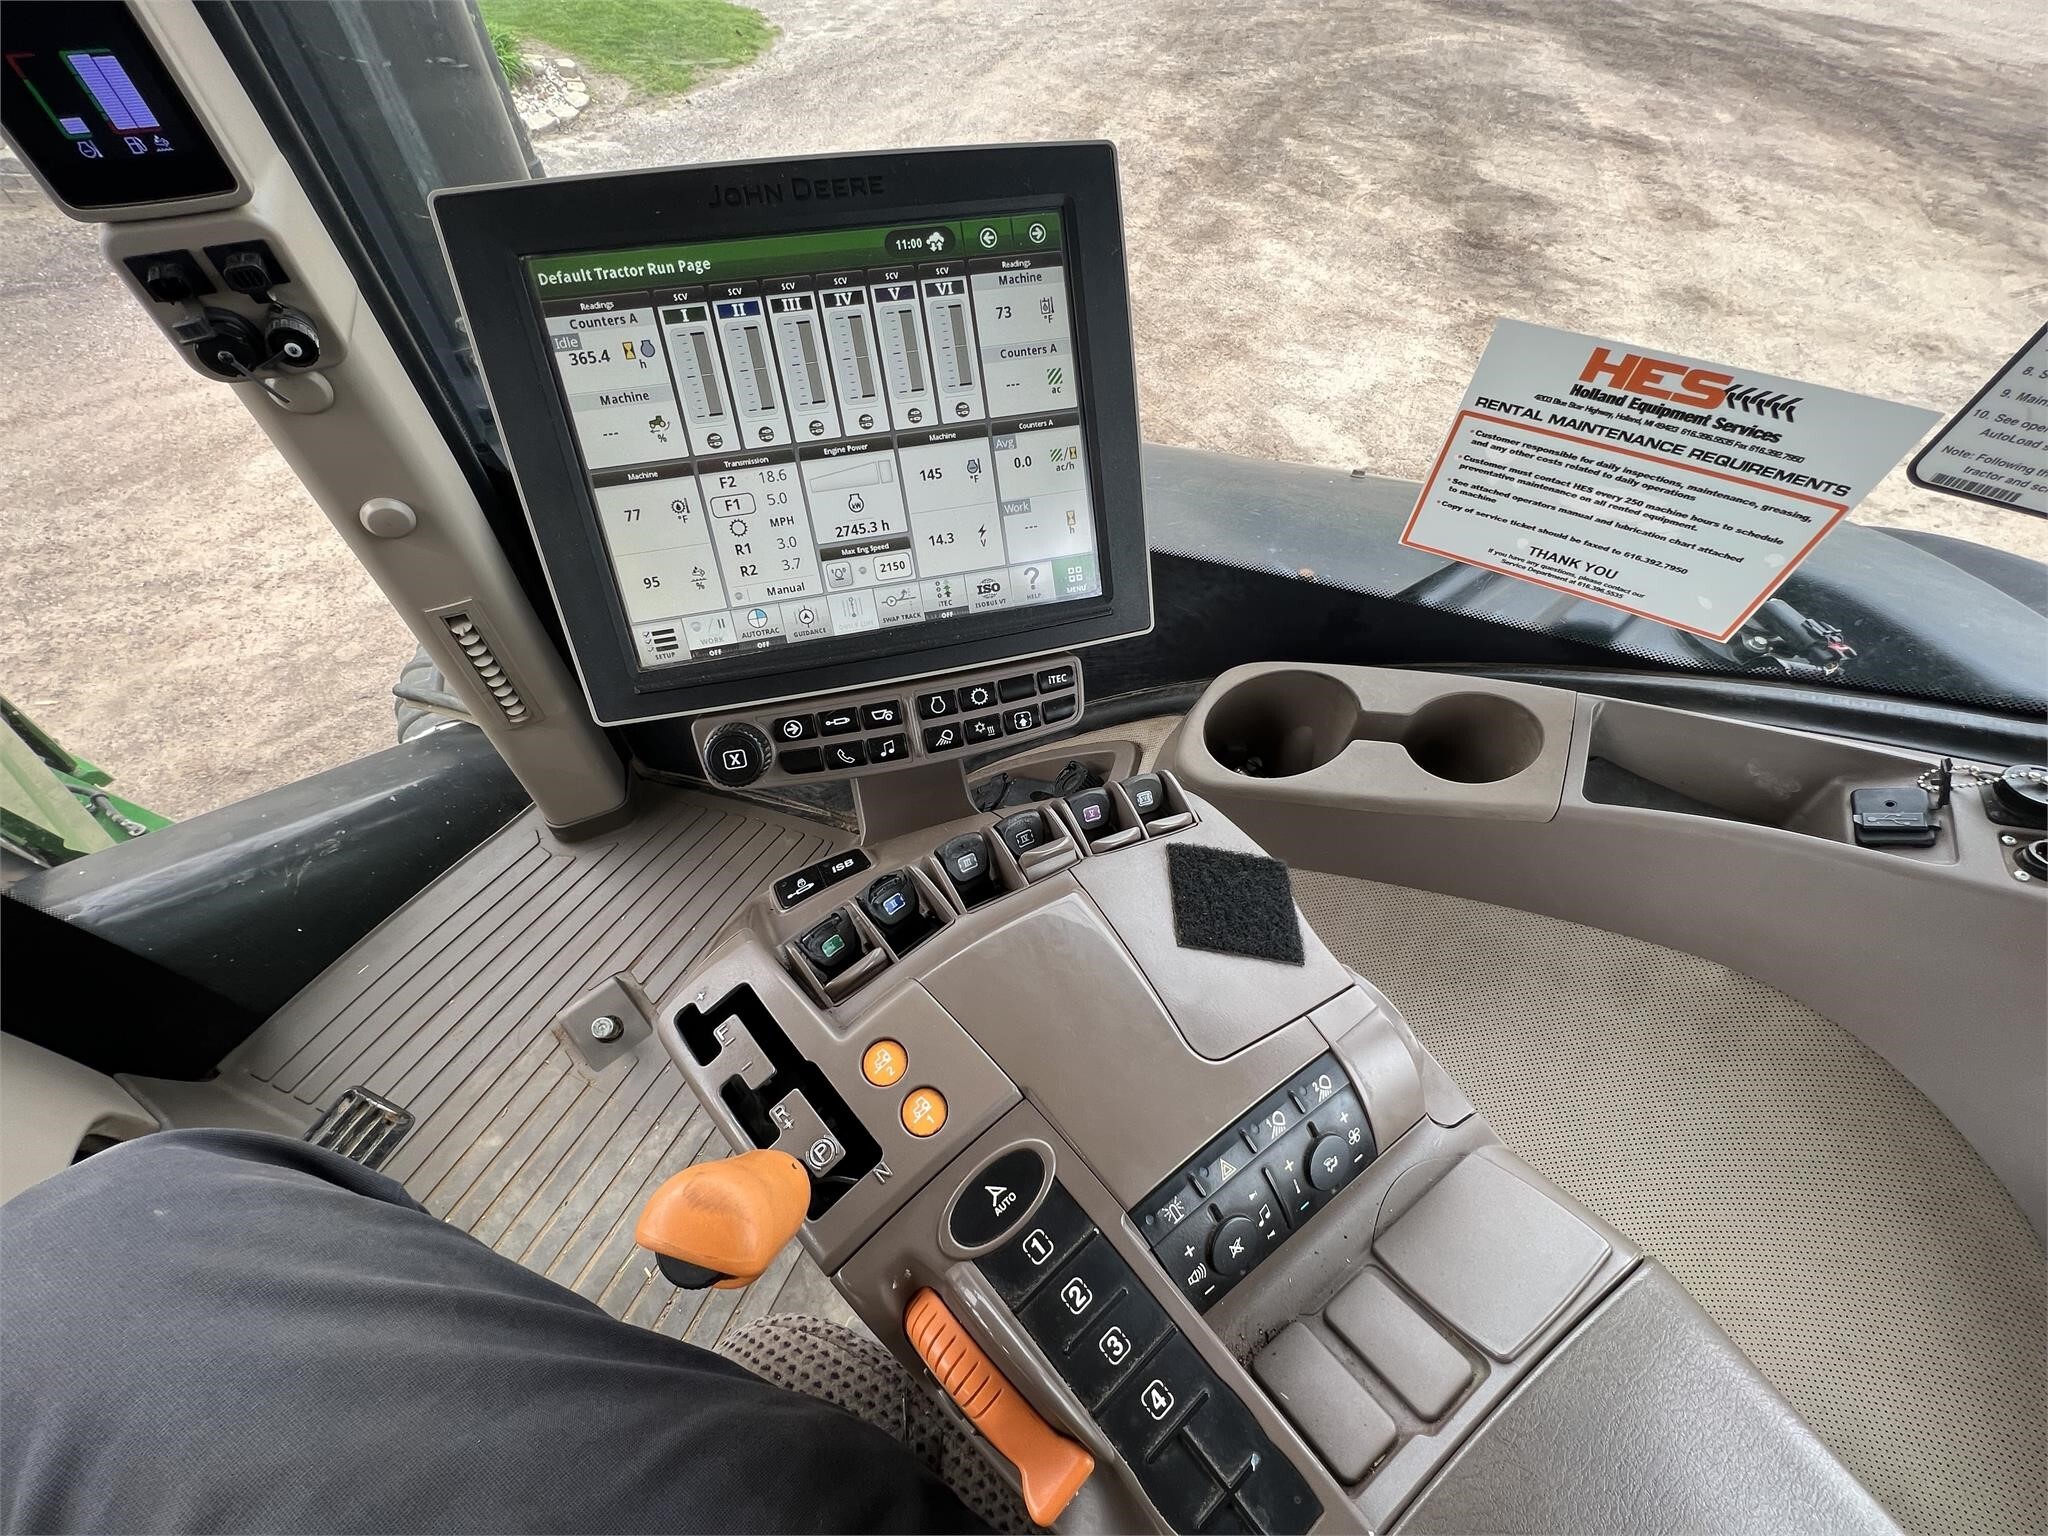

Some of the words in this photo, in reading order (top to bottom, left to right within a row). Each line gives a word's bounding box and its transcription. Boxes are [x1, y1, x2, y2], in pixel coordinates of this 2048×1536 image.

[709, 183, 783, 208] JOHN
[791, 176, 885, 200] DEERE
[895, 237, 922, 250] 11:00
[935, 266, 949, 275] SCV
[1001, 260, 1031, 268] Readings
[537, 268, 592, 285] Default
[593, 266, 643, 280] Tractor
[646, 262, 674, 275] Run
[677, 260, 711, 274] Page
[885, 272, 898, 280] SCV
[998, 272, 1042, 285] Machine
[781, 282, 795, 290] SCV
[833, 276, 847, 285] SCV
[727, 287, 742, 296] SCV
[887, 287, 900, 300] V
[935, 282, 954, 295] VI
[673, 292, 688, 301] SCV
[834, 292, 852, 306] IV
[579, 301, 614, 311] Readings
[731, 303, 746, 317] II
[781, 297, 802, 311] III
[680, 308, 689, 322] I
[995, 305, 1012, 319] 73
[569, 316, 626, 330] Counters
[629, 312, 638, 324] A
[554, 336, 578, 349] Idle
[568, 349, 610, 366] 365.4
[1000, 346, 1047, 359] Counters
[1050, 343, 1057, 353] A
[1578, 346, 1734, 410] HES
[599, 391, 649, 405] Machine
[2000, 388, 2012, 398] 9.
[1568, 383, 1628, 407] Holland
[1627, 397, 1712, 426] Equipment
[1711, 416, 1783, 443] Services
[1973, 409, 1990, 420] 10.
[1994, 414, 2020, 426] See
[1018, 421, 1047, 430] Counters
[928, 432, 956, 441] Machine
[995, 438, 1014, 449] Avg
[1979, 428, 2043, 449] AutoLoad
[823, 446, 846, 456] Engine
[846, 444, 868, 452] Power
[1474, 396, 1543, 422] RENTAL
[1547, 413, 1688, 456] MAINTENANCE
[1687, 447, 1852, 497] REQUIREMENTS
[723, 457, 769, 468] Transmission
[1014, 455, 1032, 468] 0.0
[1942, 445, 1974, 460] Note:
[1976, 453, 2036, 476] Following
[627, 471, 658, 480] Machine
[758, 468, 787, 483] 18.6
[919, 467, 942, 481] 145
[1470, 439, 1489, 448] and
[1489, 444, 1508, 454] any
[1508, 448, 1536, 459] other
[1535, 455, 1563, 466] costs
[1564, 462, 1601, 476] related
[1601, 471, 1613, 479] to
[1614, 475, 1640, 487] daily
[1640, 483, 1697, 501] operations
[1474, 429, 1521, 446] Customer
[1520, 442, 1578, 461] responsible
[1579, 455, 1595, 464] for
[1595, 460, 1622, 473] daily
[1621, 466, 1684, 491] inspections,
[1686, 484, 1759, 509] maintenance,
[1759, 504, 1812, 523] greasing,
[1963, 466, 2006, 481] tractor
[2004, 478, 2030, 488] and
[719, 475, 737, 489] F2
[766, 491, 787, 506] 5.0
[1448, 485, 1458, 493] to
[1458, 489, 1497, 504] machine
[1458, 463, 1515, 482] preventative
[1516, 478, 1578, 499] maintenance
[1578, 495, 1592, 503] on
[1592, 499, 1608, 507] all
[1607, 503, 1642, 516] rented
[1642, 512, 1698, 532] equipment.
[1463, 454, 1508, 471] Customer
[1508, 467, 1533, 478] must
[1533, 474, 1572, 488] contact
[1572, 482, 1594, 494] HES
[1594, 490, 1624, 503] every
[1623, 496, 1644, 507] 250
[1644, 503, 1689, 519] machine
[1689, 514, 1720, 528] hours
[1721, 523, 1734, 531] to
[1734, 528, 1784, 545] schedule
[724, 498, 740, 511] F1
[1003, 501, 1029, 514] Work
[624, 508, 640, 522] 77
[769, 515, 794, 527] MPH
[1451, 478, 1469, 488] See
[1470, 484, 1511, 498] attached
[1511, 495, 1556, 511] operators
[1557, 507, 1594, 521] manual
[1593, 517, 1614, 526] and
[1614, 521, 1667, 542] lubrication
[1668, 538, 1697, 550] chart
[1696, 546, 1745, 563] attached
[835, 521, 878, 538] 2745.3
[881, 519, 890, 531] h
[776, 535, 797, 550] 3.0
[928, 532, 954, 546] 14.3
[1441, 500, 1463, 512] Copy
[1475, 510, 1508, 523] service
[1509, 519, 1537, 531] ticket
[1536, 528, 1569, 540] should
[1568, 535, 1582, 544] be
[1582, 539, 1611, 552] faxed
[1623, 551, 1688, 575] 616.392.7950
[734, 542, 751, 555] R1
[856, 546, 870, 554] Eng
[869, 542, 889, 552] Speed
[781, 557, 800, 571] 3.7
[879, 560, 905, 573] 2150
[1529, 545, 1582, 570] THANK
[1584, 561, 1619, 579] YOU
[739, 564, 758, 577] R2
[1492, 550, 1508, 558] you
[1507, 553, 1526, 563] have
[1525, 559, 1540, 568] any
[1577, 575, 1603, 586] please
[1602, 582, 1632, 595] contact
[643, 576, 660, 589] 95
[766, 582, 805, 596] Manual
[976, 582, 1000, 595] ISO
[882, 615, 899, 623] SWAP
[901, 612, 921, 620] TRACK
[741, 627, 780, 639] AUTOTRAC
[793, 627, 826, 638] GUIDANCE
[655, 651, 675, 660] SETUP
[1048, 672, 1068, 684] iTEC
[831, 858, 855, 874] ISB
[814, 1143, 827, 1161] P
[873, 1161, 894, 1184] N
[994, 1192, 1017, 1216] AUTO
[1030, 1238, 1046, 1254] 1
[1068, 1285, 1086, 1306] 2
[1106, 1334, 1124, 1356] 3
[1149, 1388, 1166, 1410] 4
